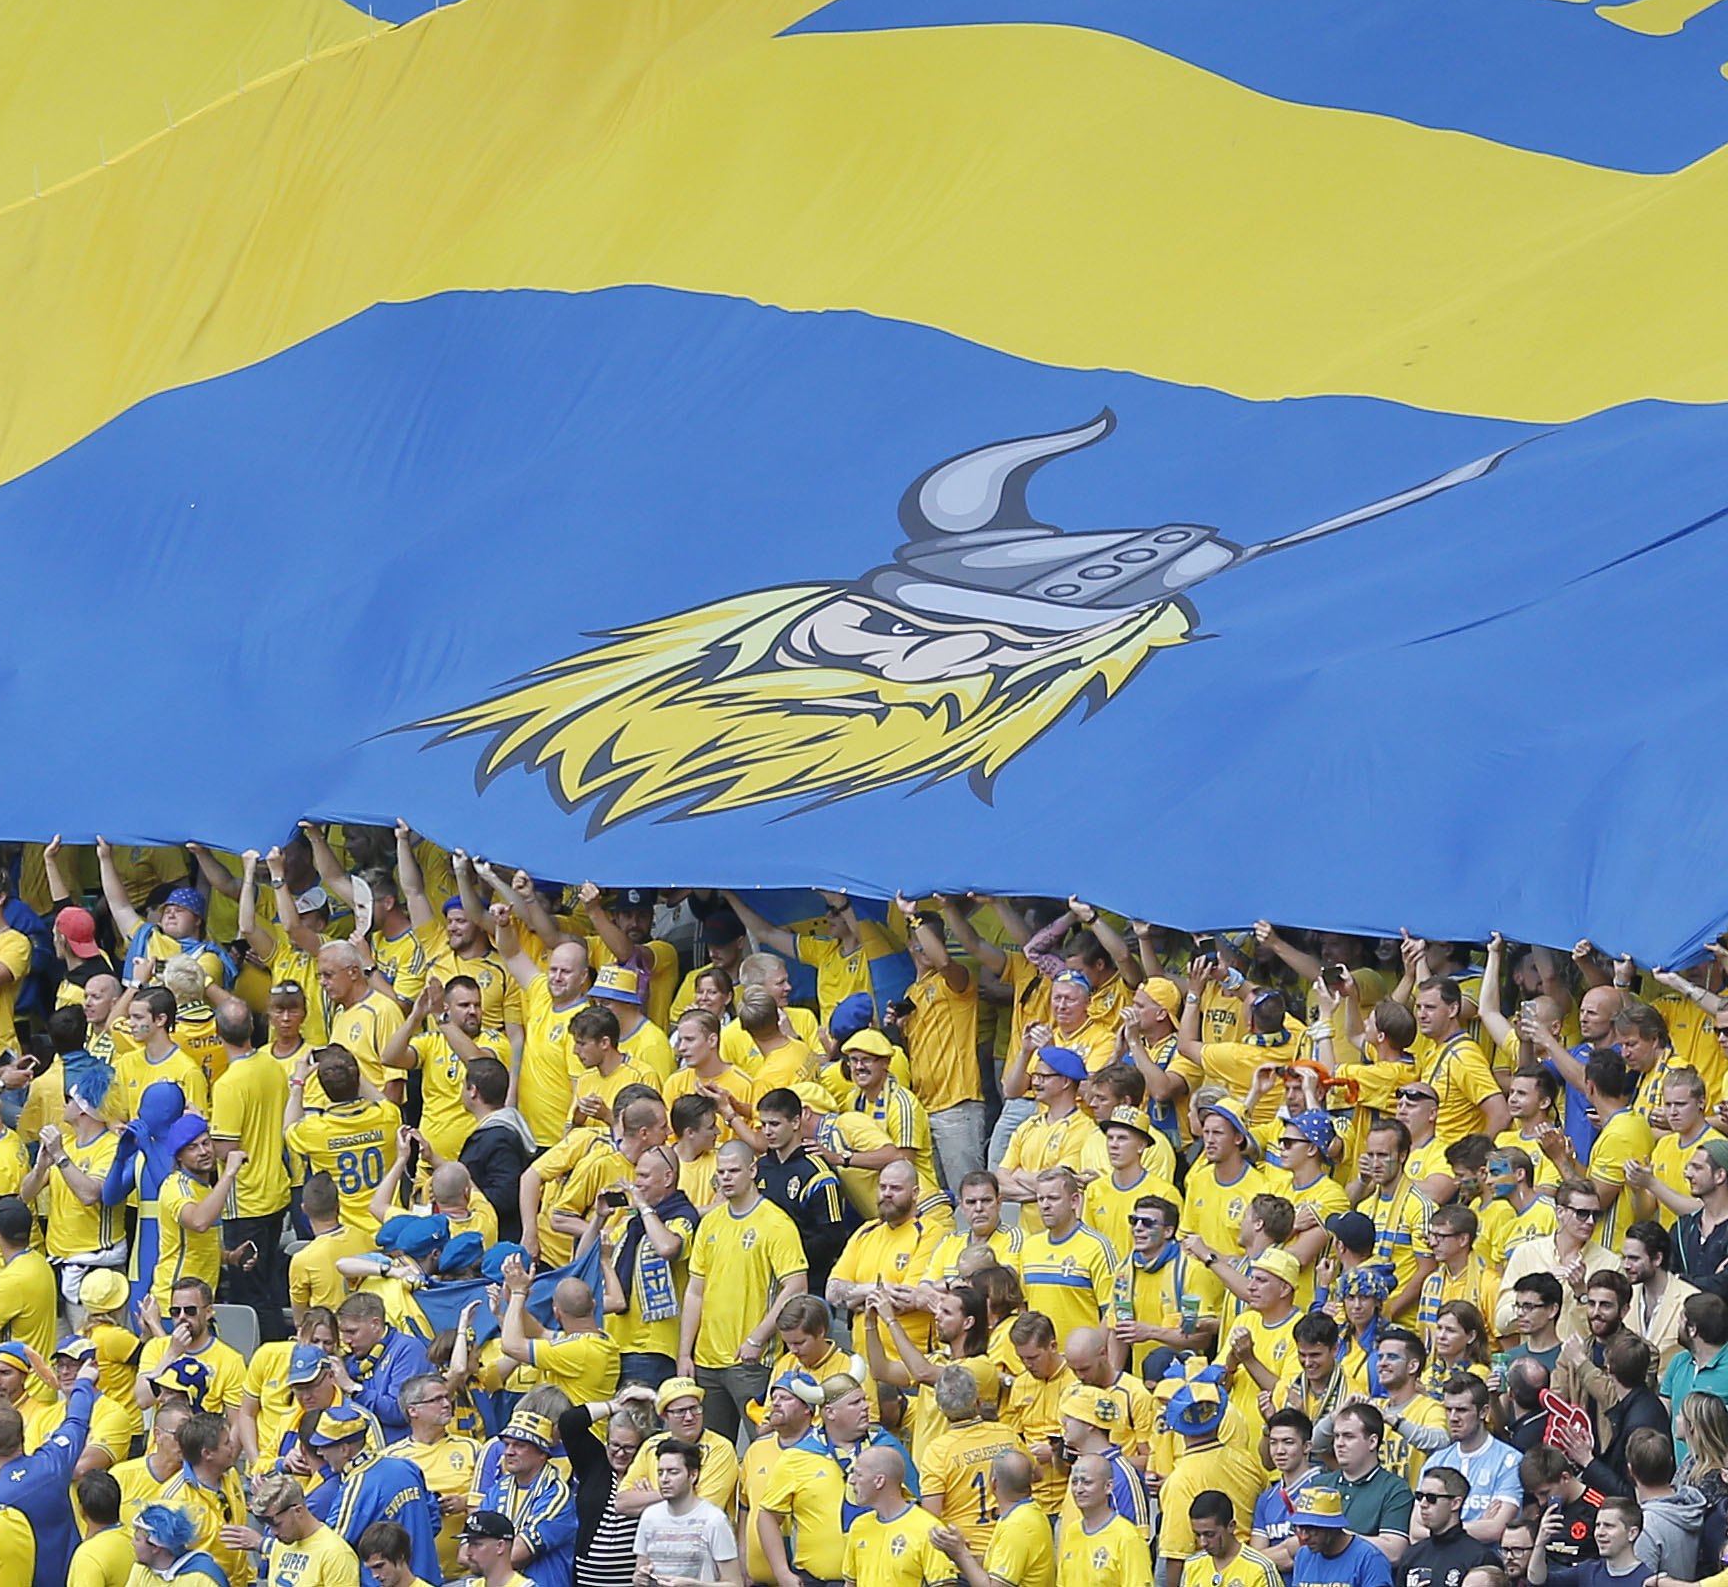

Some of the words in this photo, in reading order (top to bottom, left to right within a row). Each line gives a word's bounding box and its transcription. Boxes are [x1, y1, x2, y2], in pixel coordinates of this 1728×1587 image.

[327, 1130, 384, 1150] BERGSTRÖM
[337, 1147, 384, 1194] 80
[278, 1553, 310, 1573] SUPER
